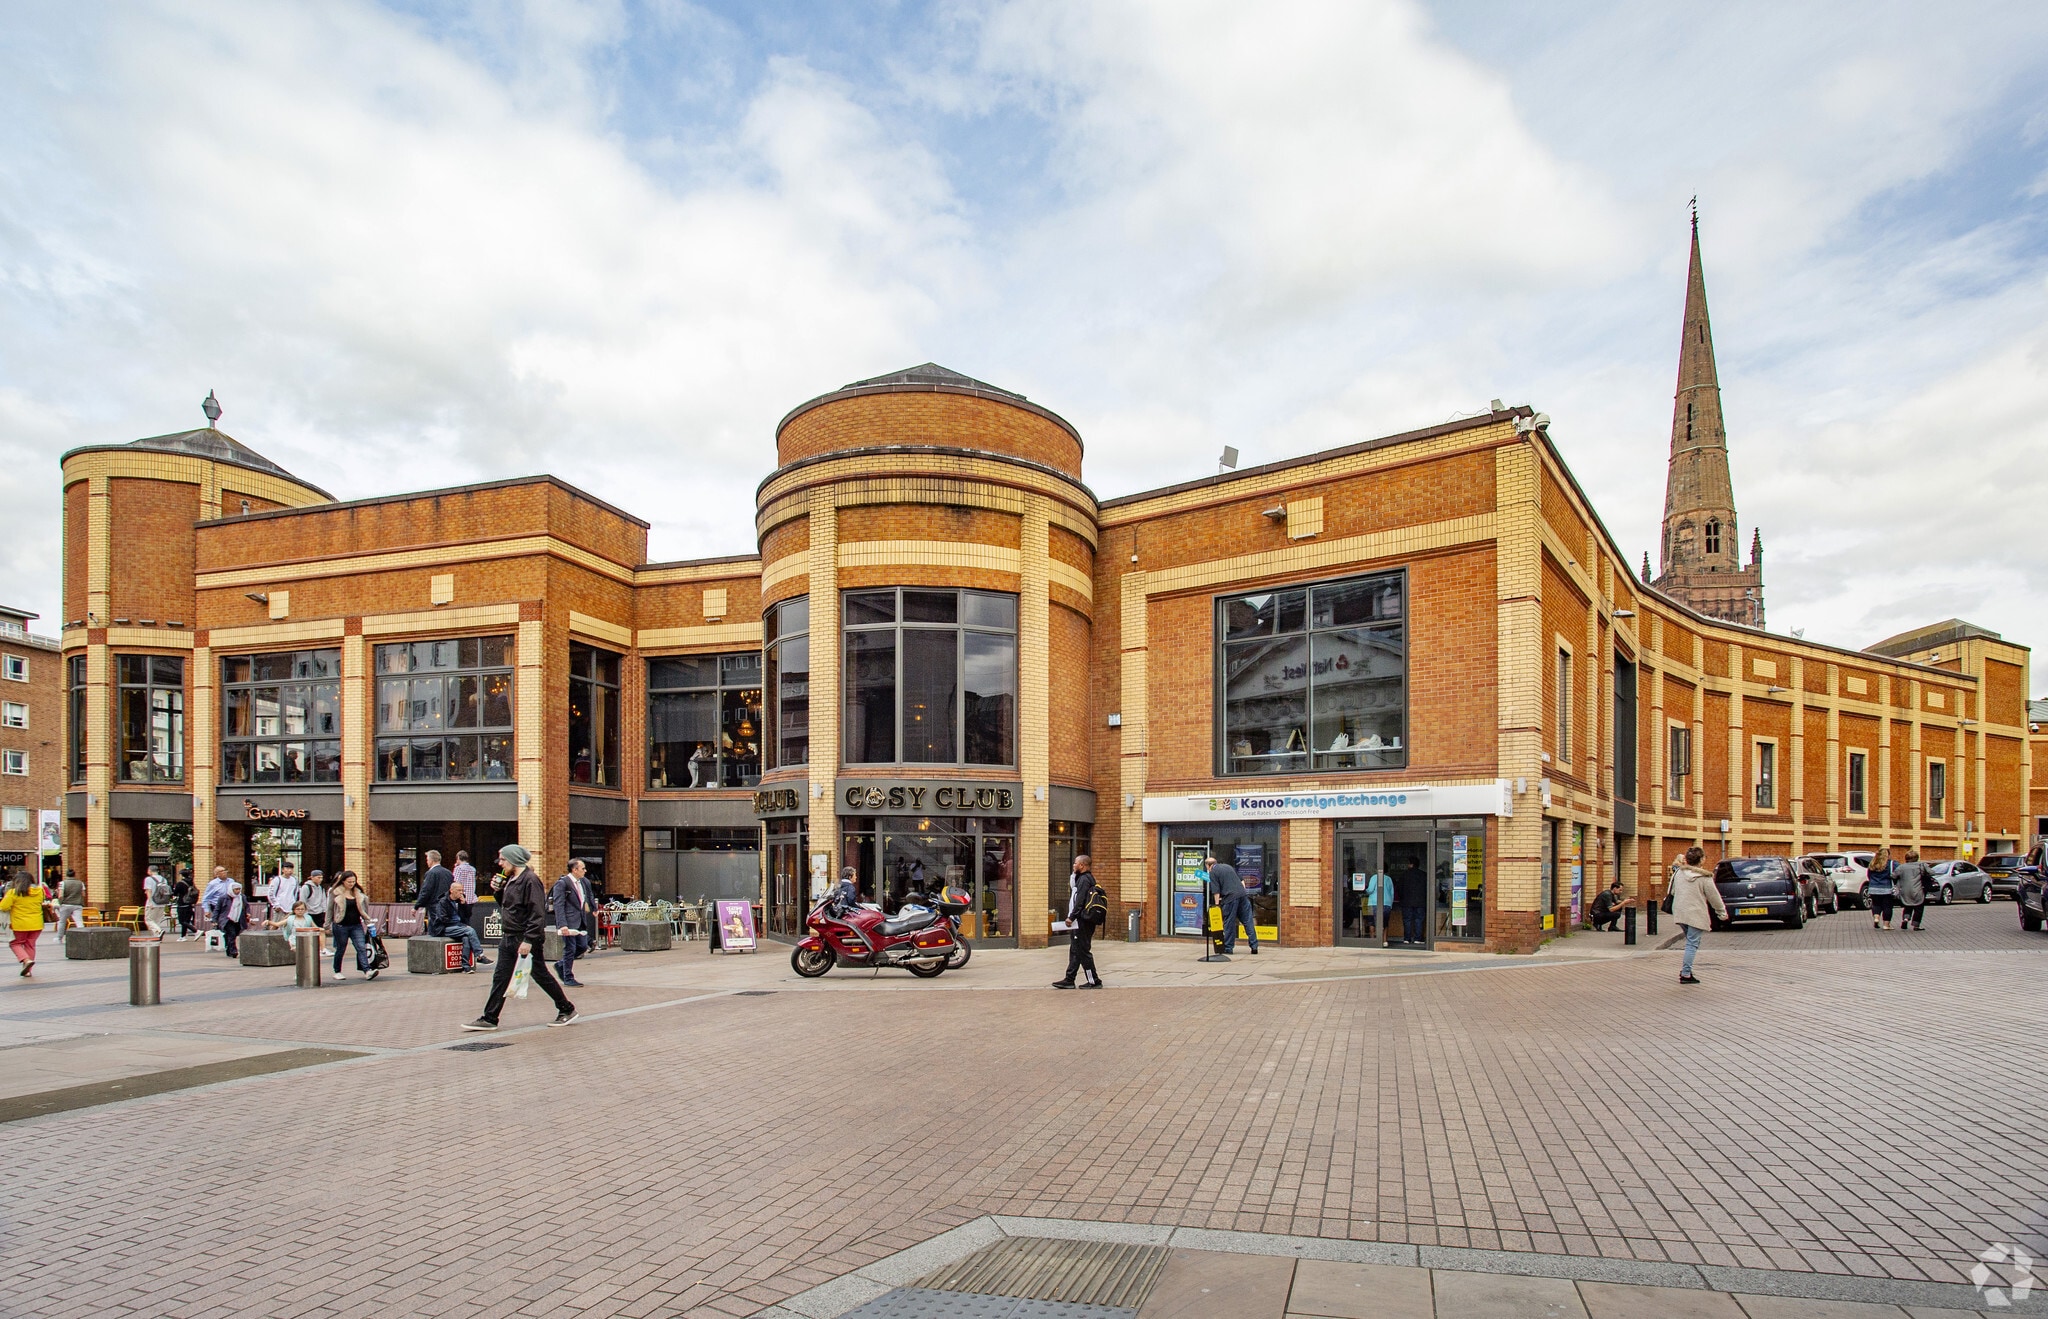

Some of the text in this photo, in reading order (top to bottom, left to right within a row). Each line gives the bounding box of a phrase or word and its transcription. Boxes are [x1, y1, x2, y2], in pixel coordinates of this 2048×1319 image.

[760, 789, 799, 811] CLUB
[935, 787, 1014, 810] CLUB
[1274, 808, 1307, 816] Commission
